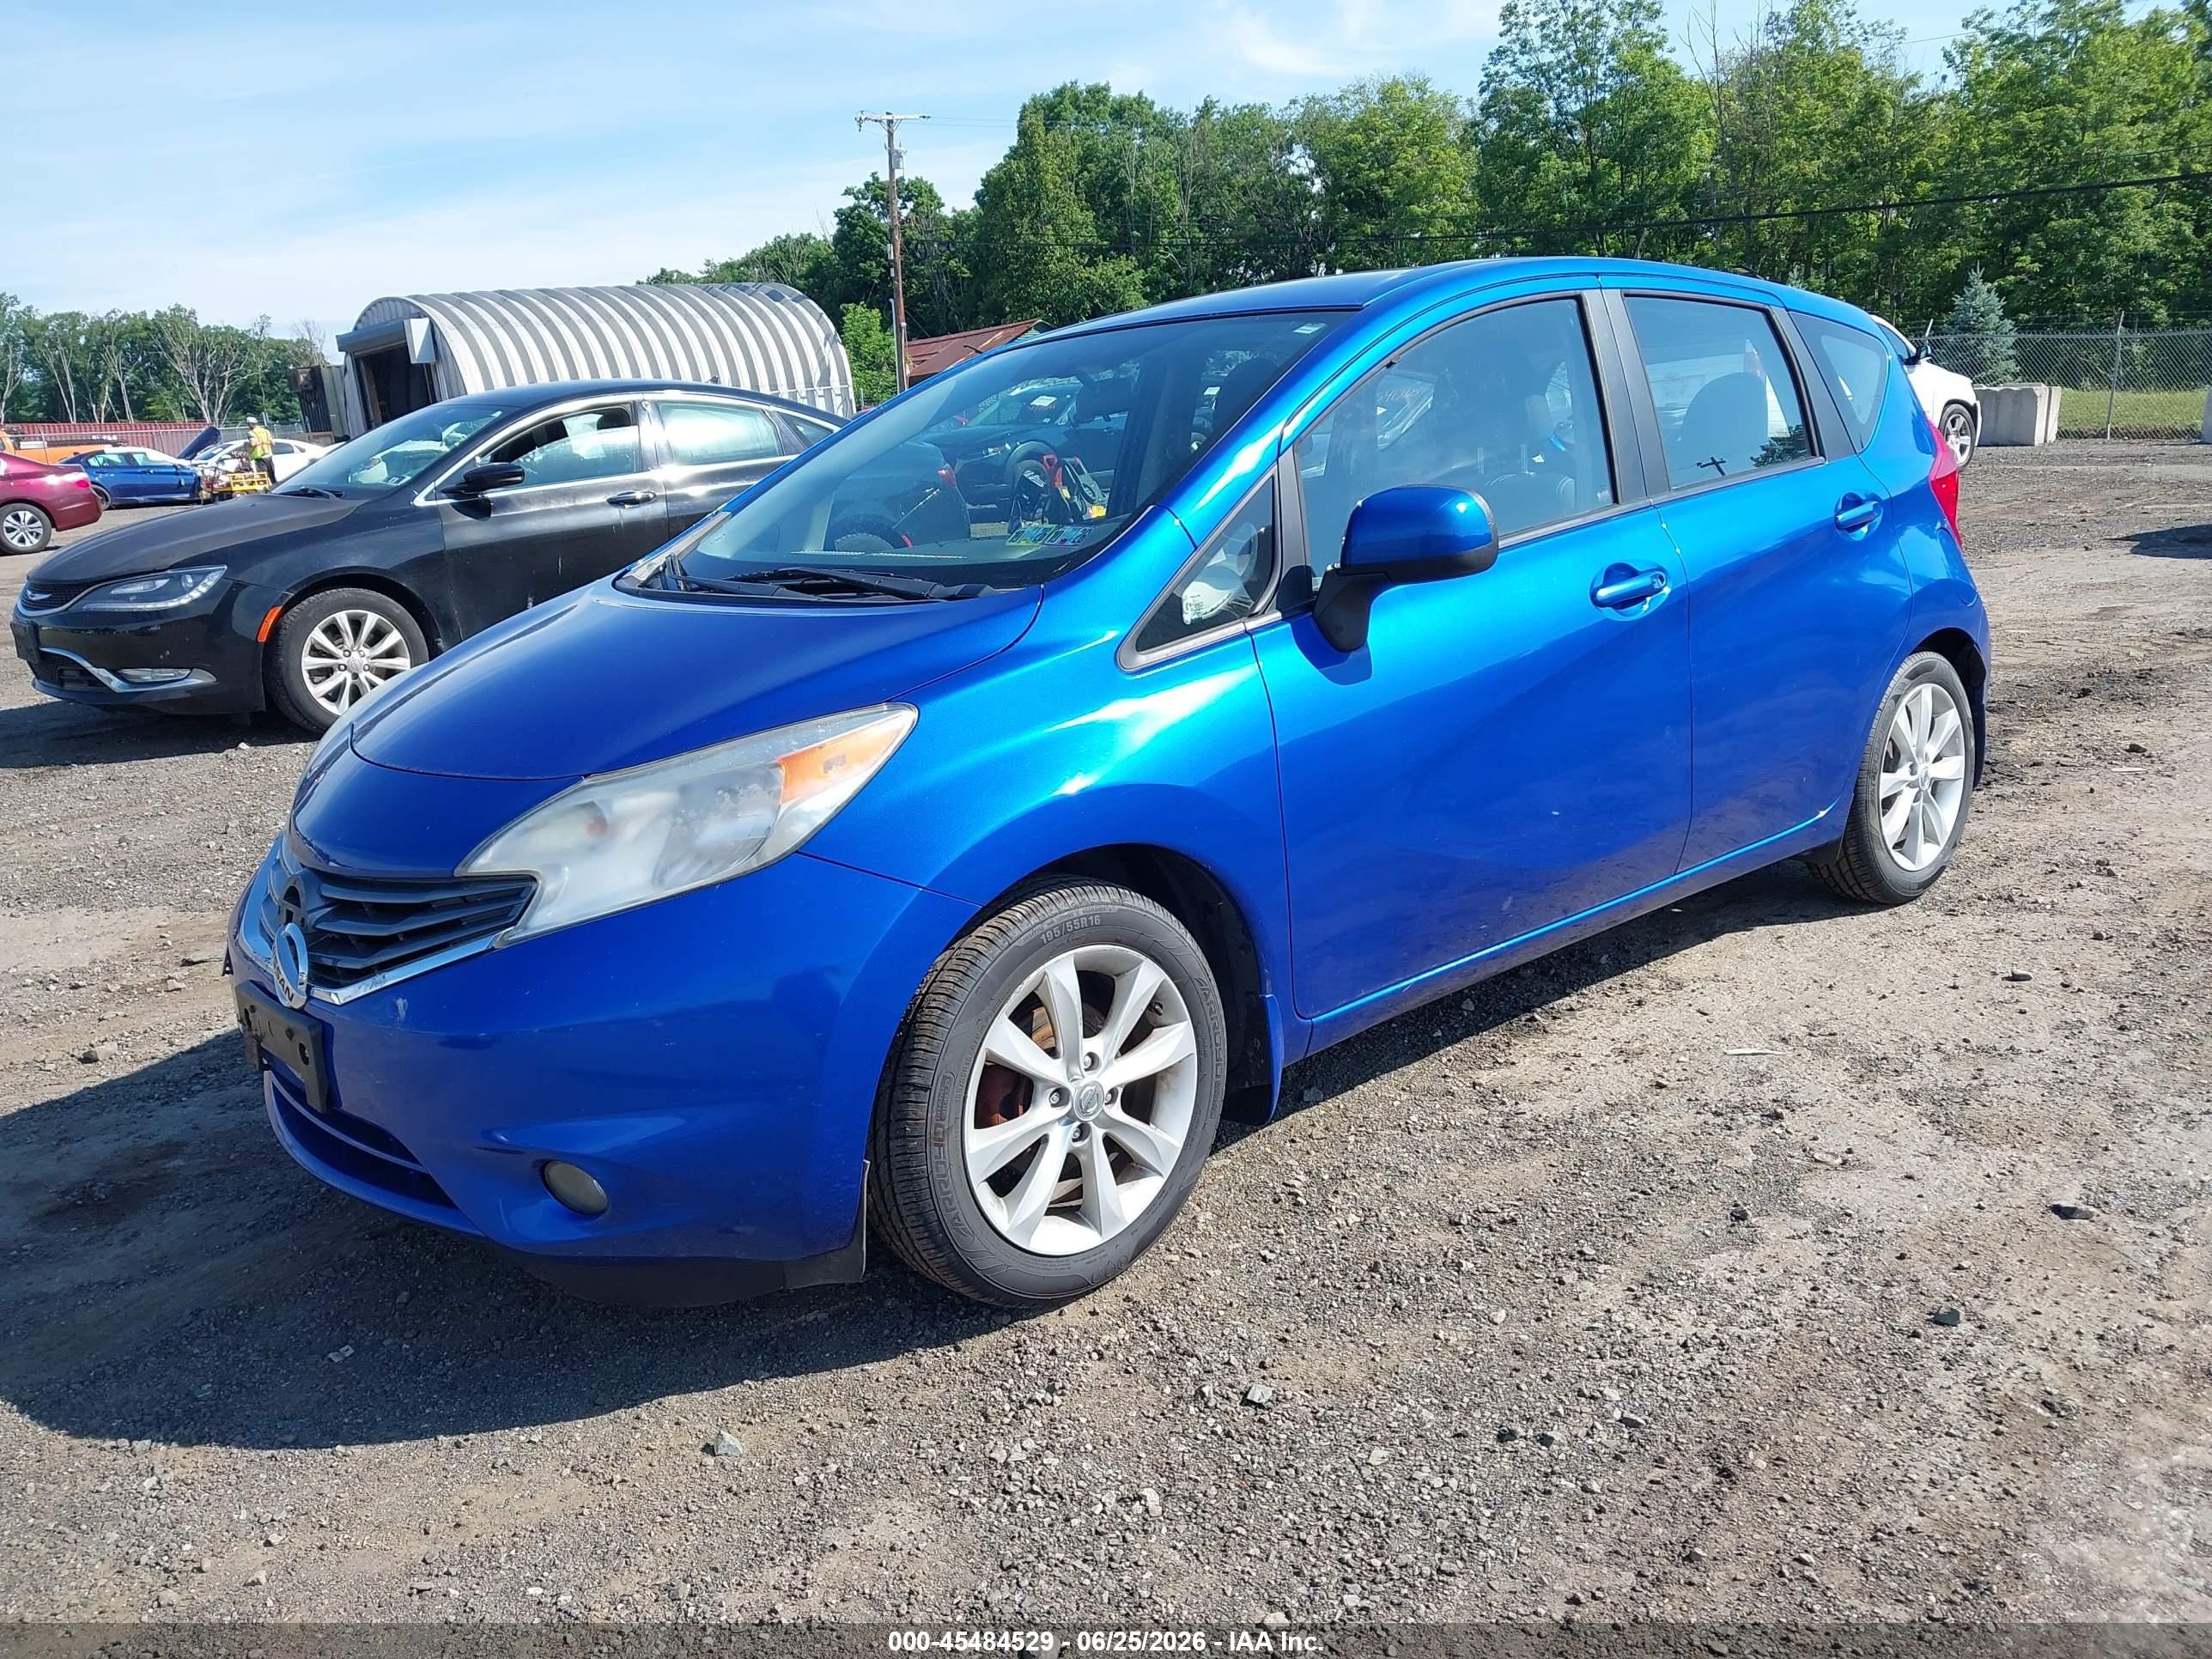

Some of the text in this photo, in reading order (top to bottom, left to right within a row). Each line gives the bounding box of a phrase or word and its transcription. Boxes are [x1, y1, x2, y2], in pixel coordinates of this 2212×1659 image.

[1040, 915, 1100, 945] 195/55R16
[273, 946, 295, 1002] SSAN
[933, 1126, 969, 1237] ARROYO
